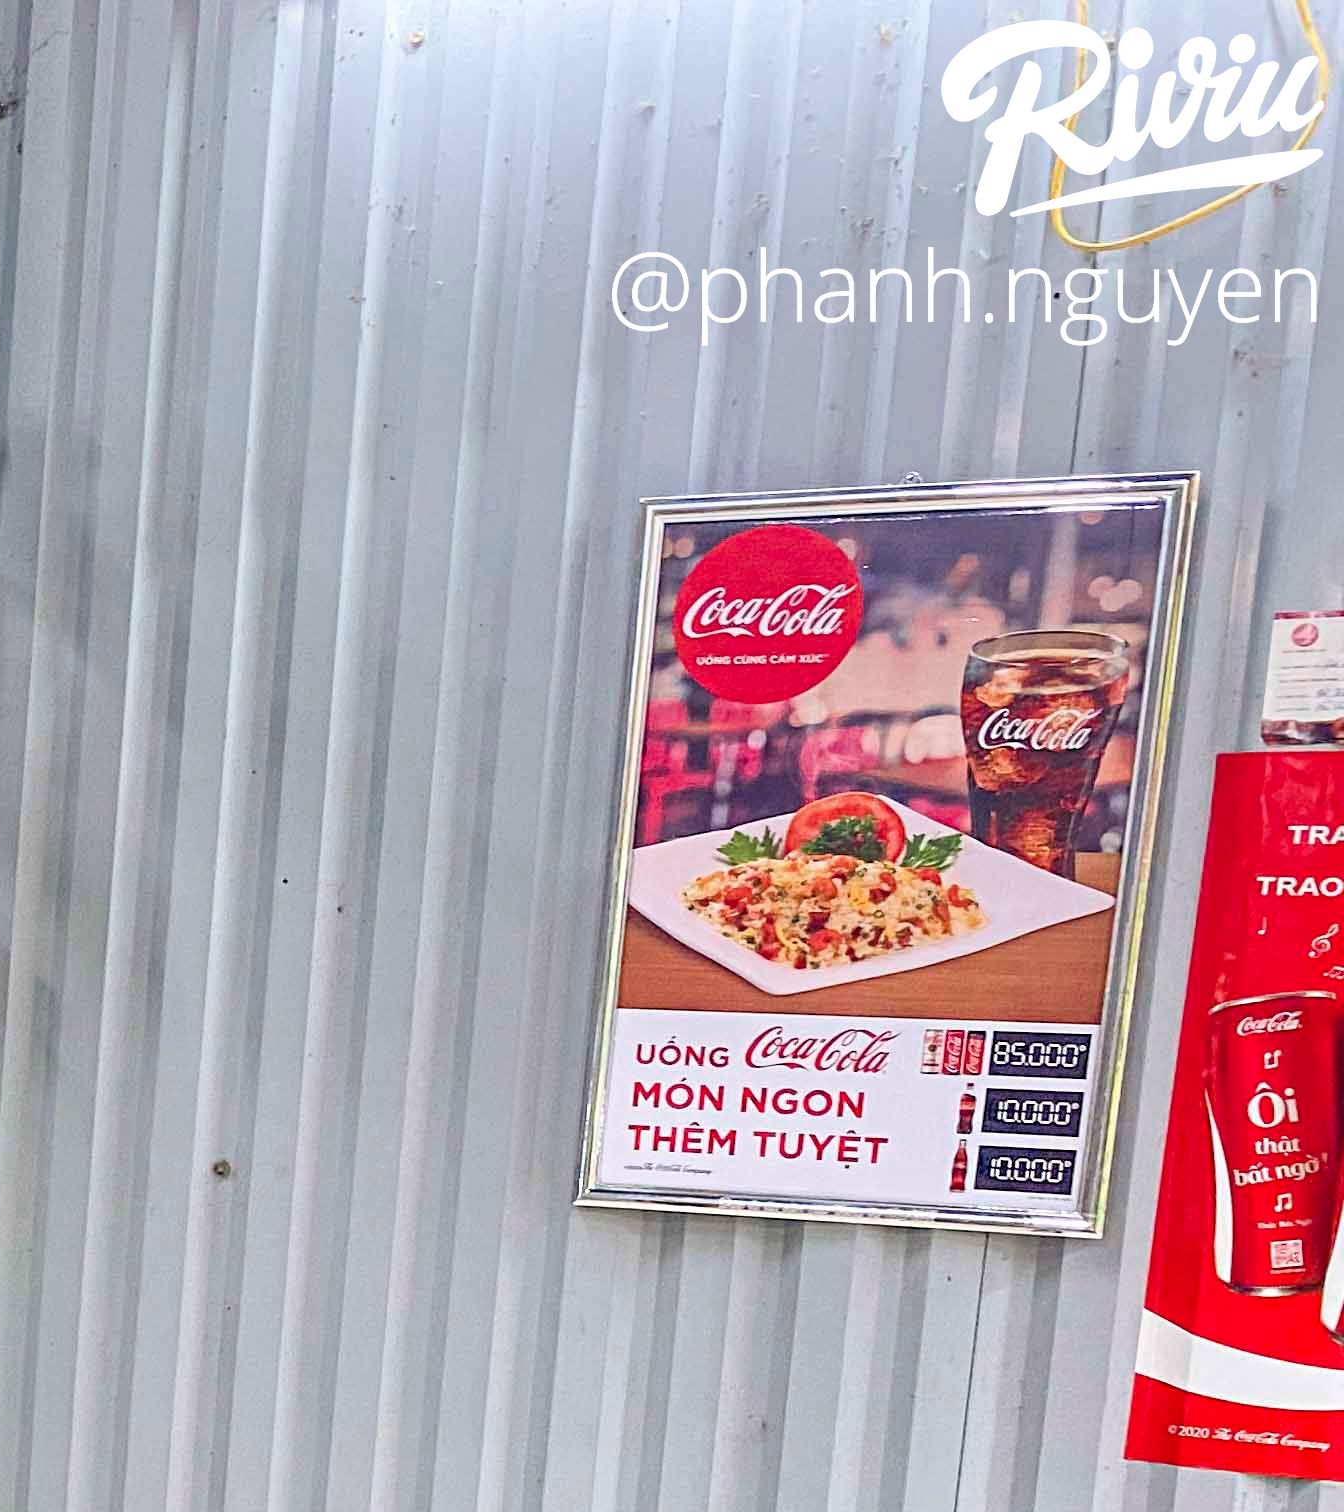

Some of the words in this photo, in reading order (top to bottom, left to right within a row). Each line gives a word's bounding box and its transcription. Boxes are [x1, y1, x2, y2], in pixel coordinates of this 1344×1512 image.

[682, 583, 857, 640] Coca-Cola
[979, 708, 1102, 751] Coca-Cola
[1256, 876, 1344, 897] TRAO
[636, 1034, 730, 1068] UỐNG
[744, 1025, 902, 1075] Coca-Cola
[632, 1077, 727, 1110] MÓN
[740, 1086, 866, 1118] NGON
[1247, 1082, 1299, 1129] Ôi
[627, 1122, 738, 1157] THÊM
[746, 1129, 890, 1170] TUYỆT
[1255, 1135, 1302, 1156] thật
[1233, 1161, 1275, 1186] bất
